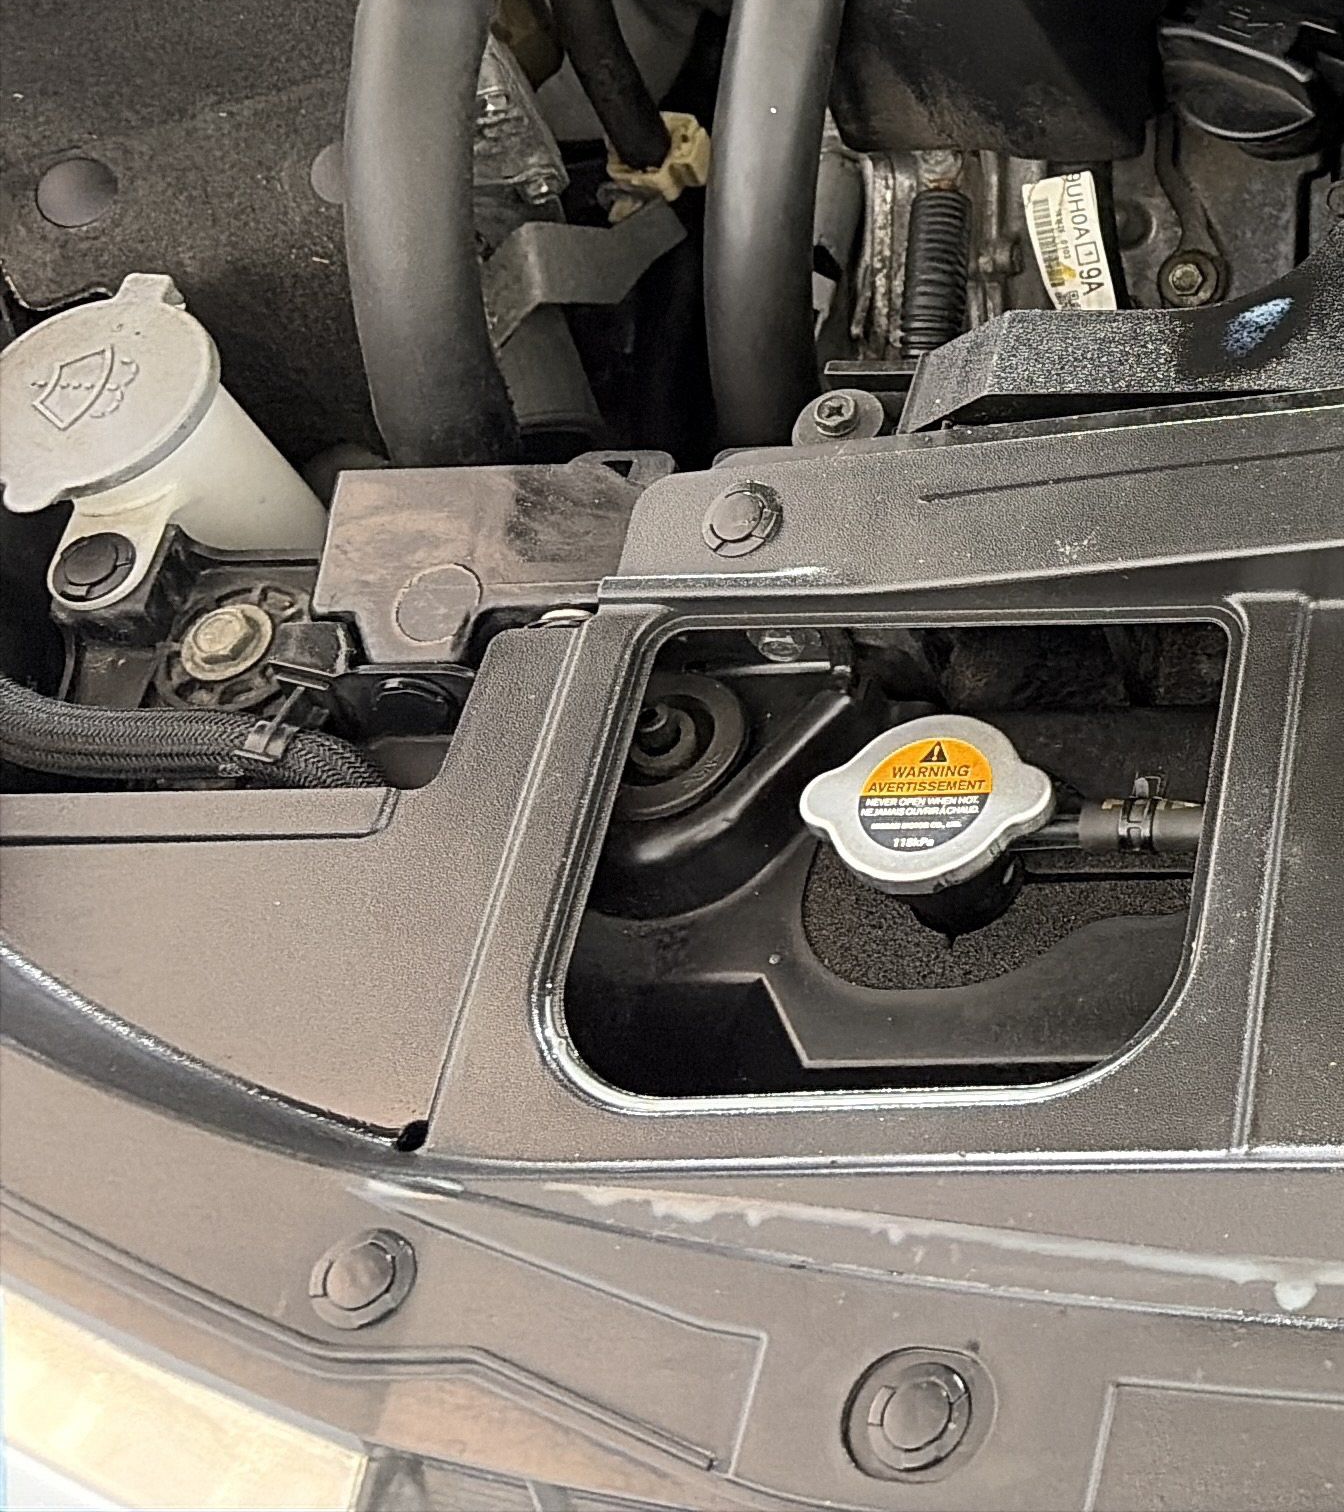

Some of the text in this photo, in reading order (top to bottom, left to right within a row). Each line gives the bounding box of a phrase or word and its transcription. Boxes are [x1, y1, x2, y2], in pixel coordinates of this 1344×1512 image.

[1079, 268, 1105, 296] 9A
[892, 764, 970, 778] WARNING
[868, 780, 986, 793] AVERTISSEMENT
[865, 798, 898, 806] NEVER
[898, 797, 926, 806] OPEN
[927, 796, 957, 805] WHEN
